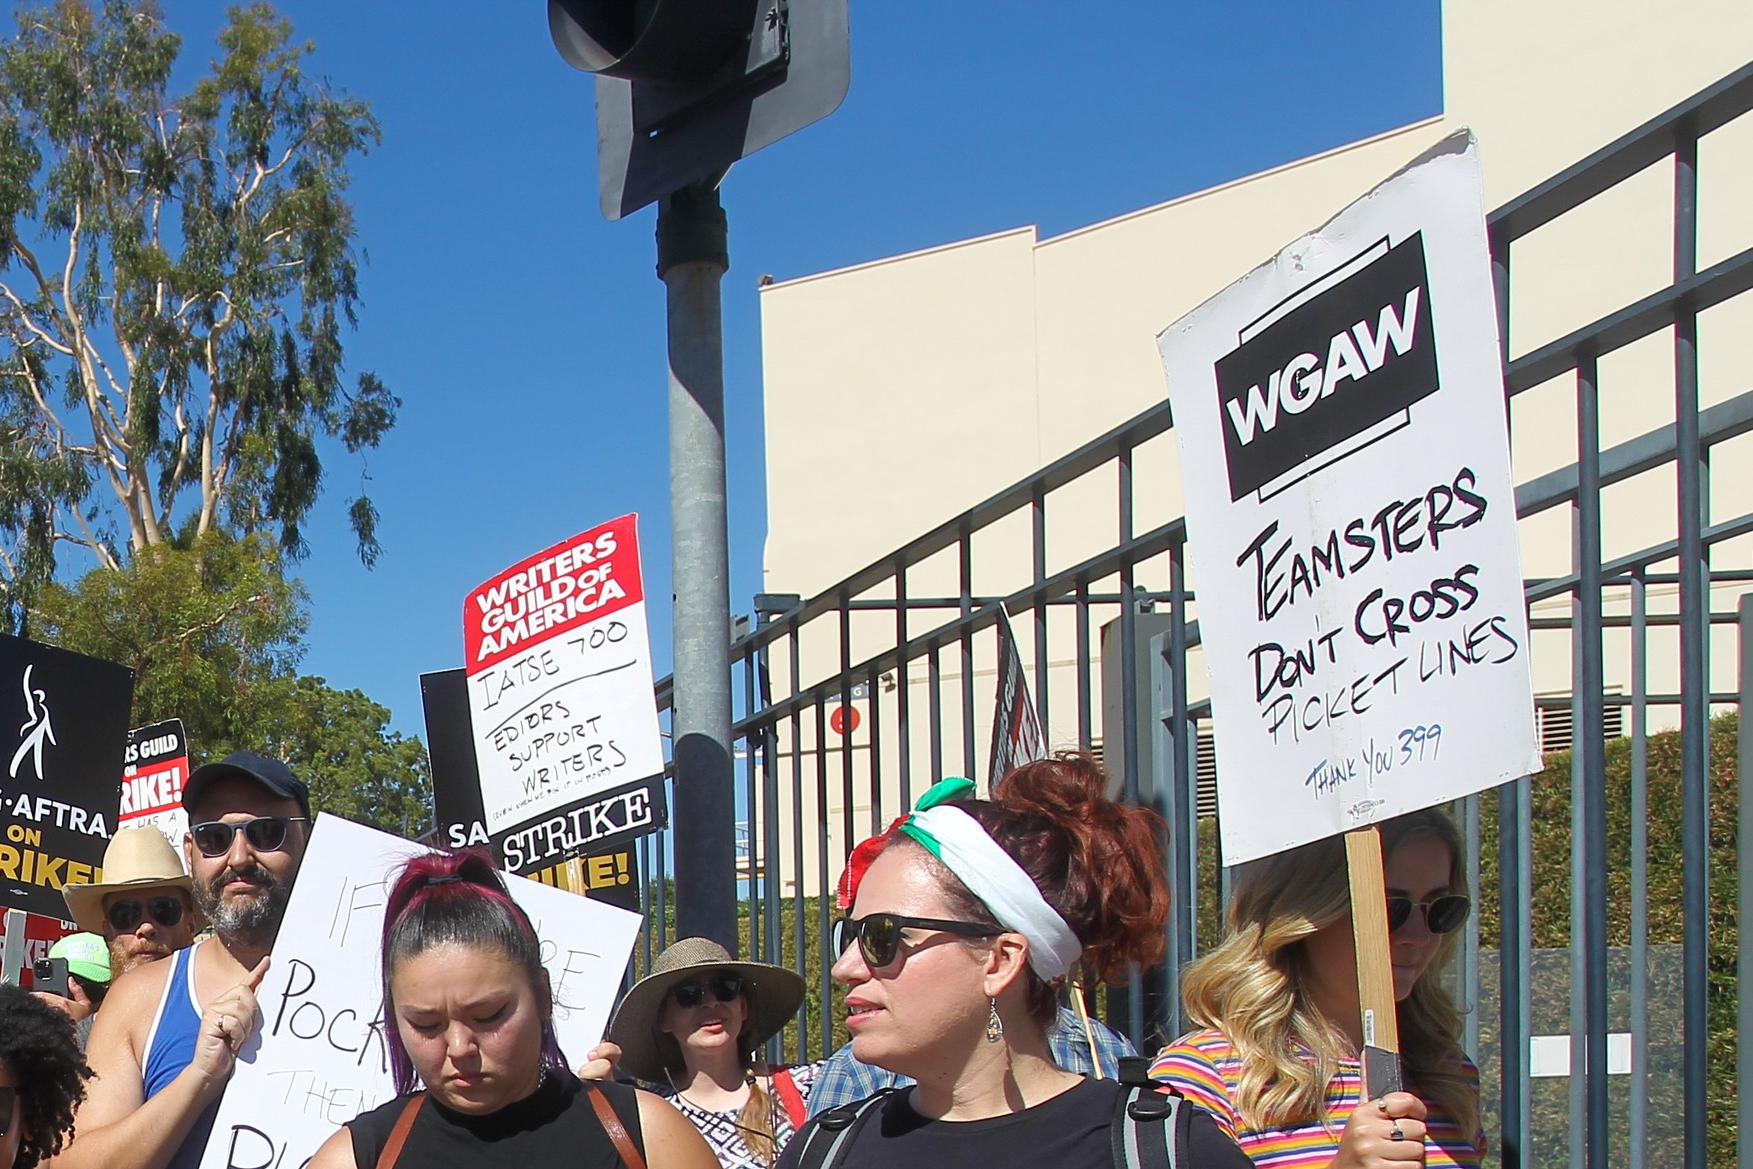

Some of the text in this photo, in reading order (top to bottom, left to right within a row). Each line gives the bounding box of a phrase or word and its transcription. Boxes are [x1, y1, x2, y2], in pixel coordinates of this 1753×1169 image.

[1225, 285, 1420, 447] WGAW
[476, 531, 617, 614] WRITERS
[1237, 467, 1488, 622] TEAMSTERS
[477, 578, 627, 662] AMERICA
[481, 562, 612, 634] GUILD OF
[1354, 564, 1480, 648] CROSS
[477, 621, 628, 711] IATSE 700
[1261, 616, 1518, 745] PICKET LINES
[139, 733, 179, 760] GUILD
[509, 715, 601, 772] SUPPORT
[522, 740, 626, 796] WRITERS
[1305, 724, 1442, 799] THANK YOU 399
[119, 766, 183, 816] RIKE!
[503, 787, 652, 873] STRIKE
[6, 824, 42, 847] ON
[328, 875, 388, 948] IF
